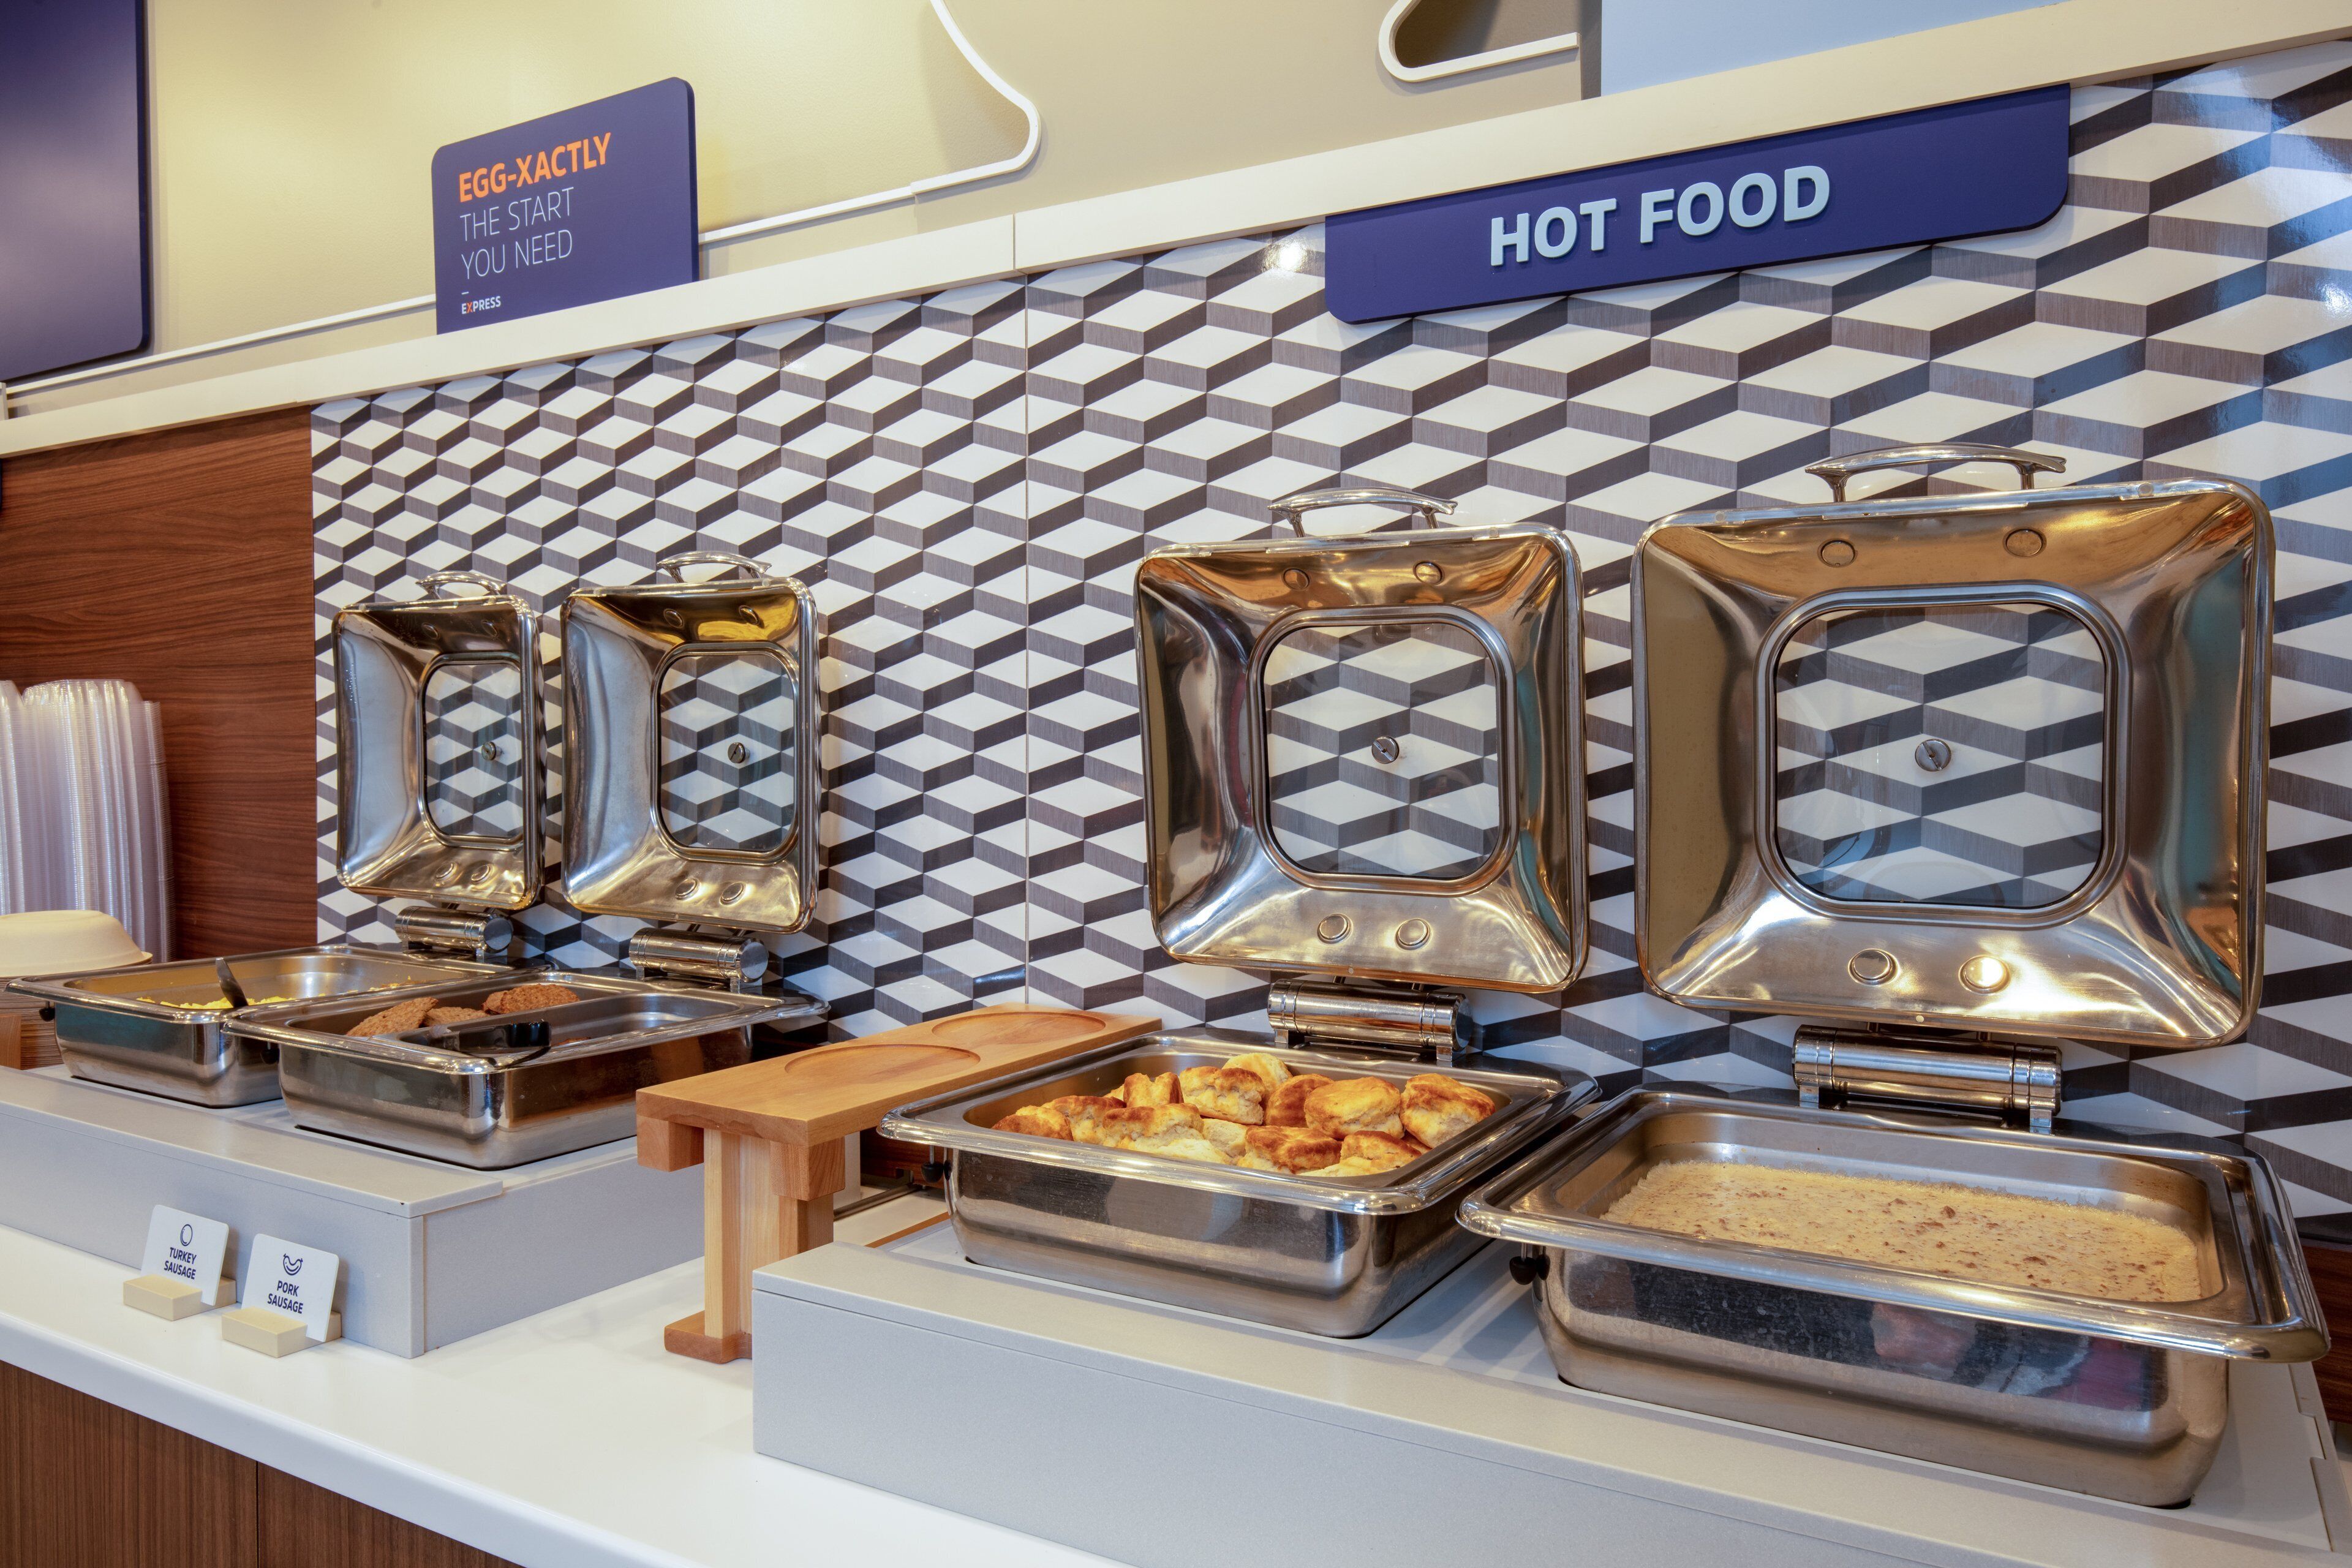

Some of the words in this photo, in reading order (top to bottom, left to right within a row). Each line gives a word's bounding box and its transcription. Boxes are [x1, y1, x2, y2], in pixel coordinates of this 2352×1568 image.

[459, 132, 611, 202] EGG-XACTLY
[460, 206, 500, 241] THE
[508, 187, 574, 230] START
[1491, 198, 1617, 266] HOT
[1640, 165, 1831, 243] FOOD
[461, 244, 505, 279] YOU
[515, 230, 573, 268] NEED
[461, 295, 501, 314] EXPRESS
[169, 1246, 197, 1265] TURKEY
[164, 1260, 196, 1280] SAUSAGE
[276, 1280, 299, 1297] PORK
[267, 1293, 304, 1314] SAUSAGE
